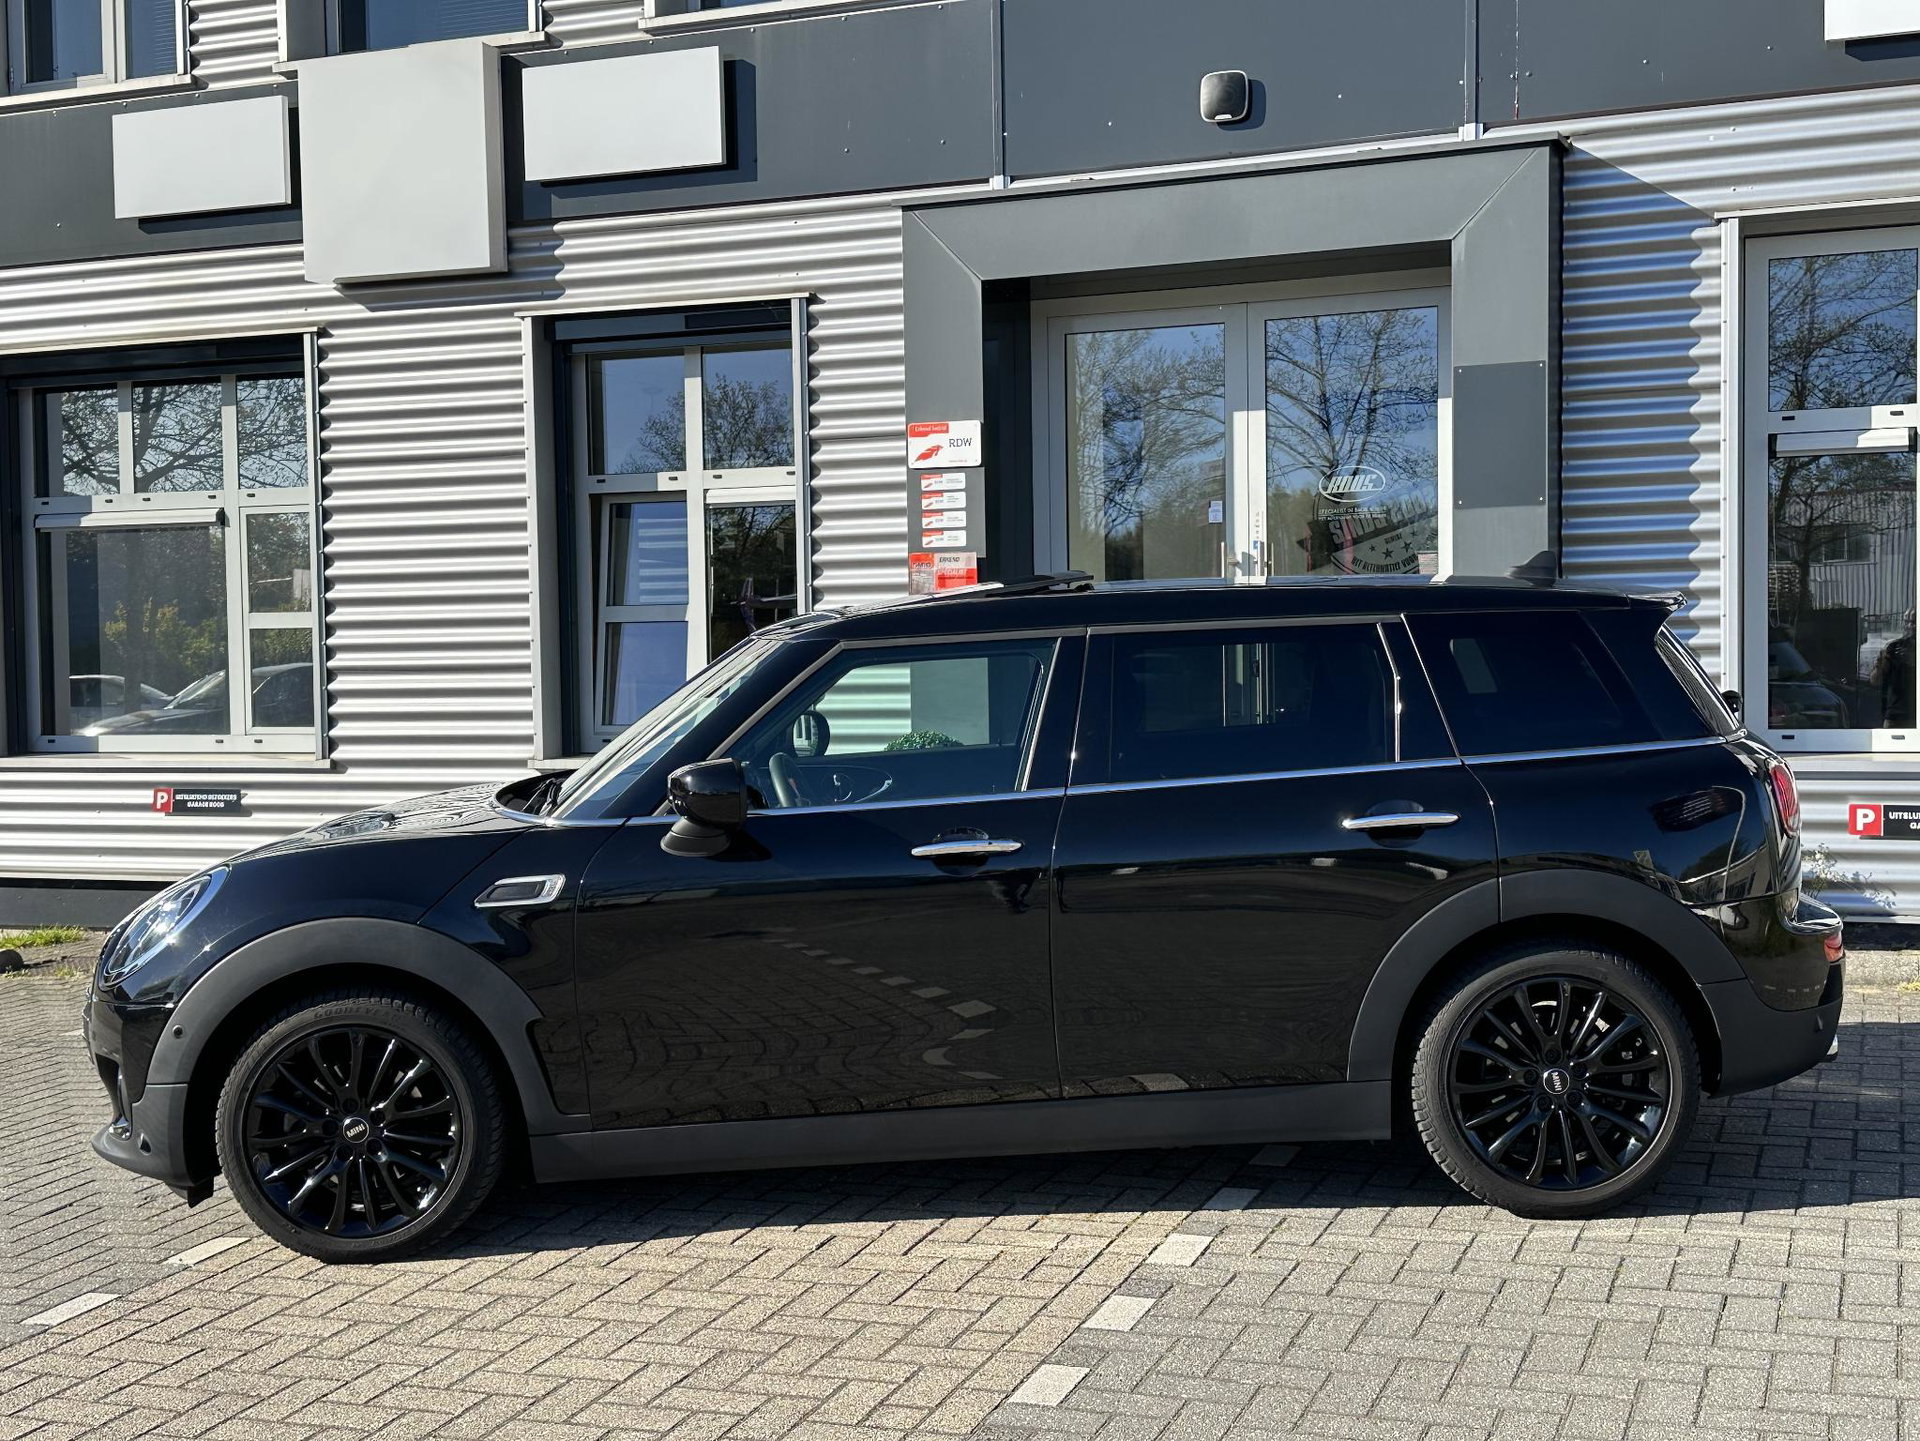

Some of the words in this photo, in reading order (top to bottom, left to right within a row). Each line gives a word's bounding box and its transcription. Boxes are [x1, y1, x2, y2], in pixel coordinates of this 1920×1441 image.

[949, 437, 973, 448] RDW
[1326, 474, 1378, 493] ROOS
[1328, 511, 1389, 546] SINDS
[156, 791, 169, 809] P
[1856, 808, 1876, 831] P
[1888, 811, 1920, 820] UITSLU
[1551, 1071, 1563, 1091] MINI
[346, 1123, 366, 1138] MINI
